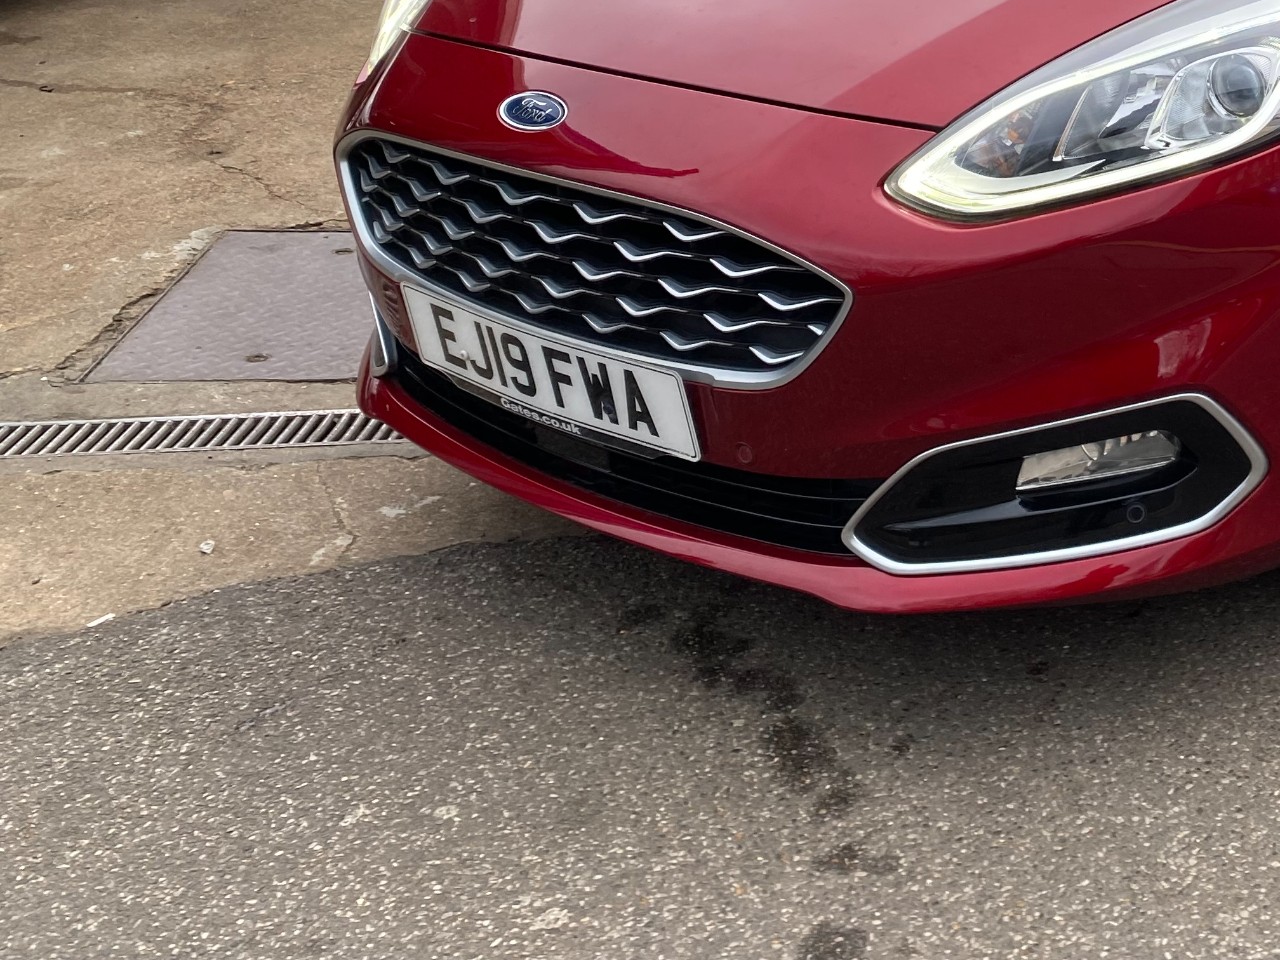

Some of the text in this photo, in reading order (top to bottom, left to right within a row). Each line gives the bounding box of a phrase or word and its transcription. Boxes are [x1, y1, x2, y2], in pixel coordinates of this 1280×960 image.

[512, 98, 552, 122] Ford
[430, 302, 660, 438] EJ19 FWA
[501, 397, 581, 435] Gates.co.uk
